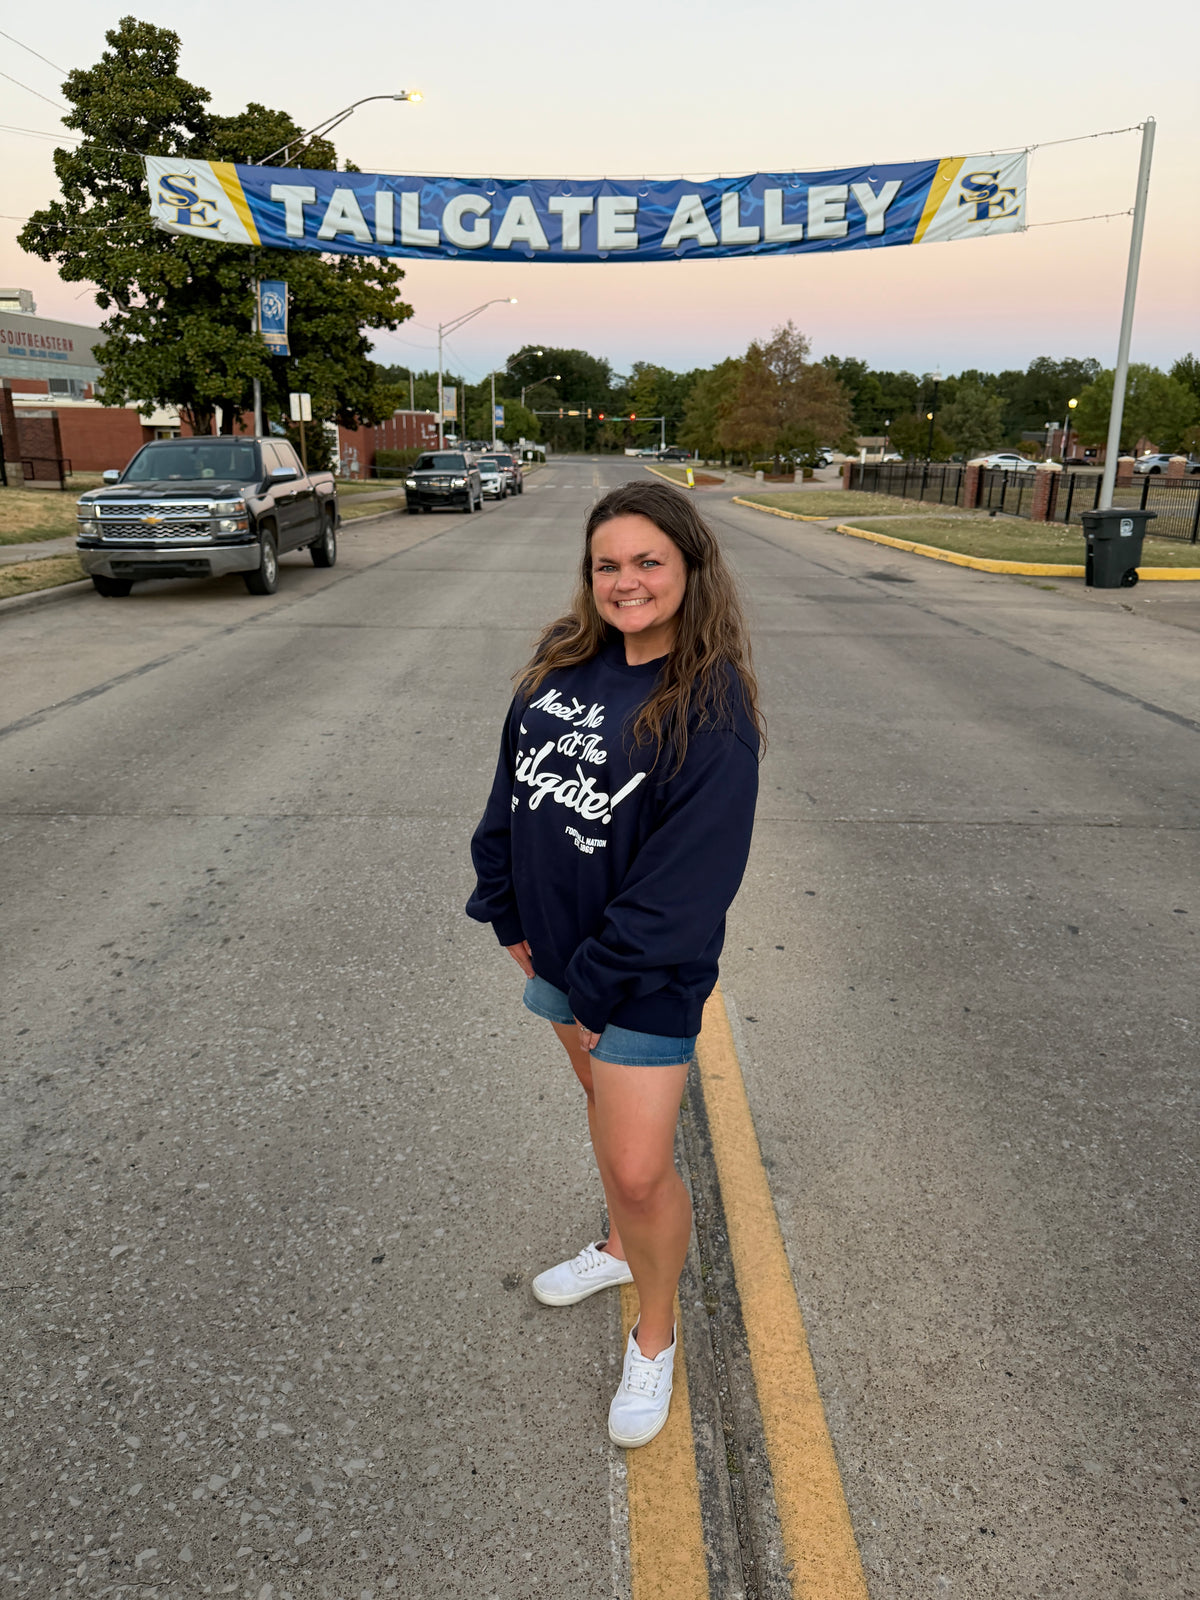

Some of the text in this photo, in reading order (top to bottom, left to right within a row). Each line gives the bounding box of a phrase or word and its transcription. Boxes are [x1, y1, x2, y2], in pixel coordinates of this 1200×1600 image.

[270, 180, 903, 253] TAILGATE ALLEY
[0, 329, 74, 352] SOUTHEASTERN
[530, 689, 605, 728] Meet Me
[578, 733, 607, 765] The
[515, 723, 646, 825] ilgate!
[585, 837, 607, 848] NATION
